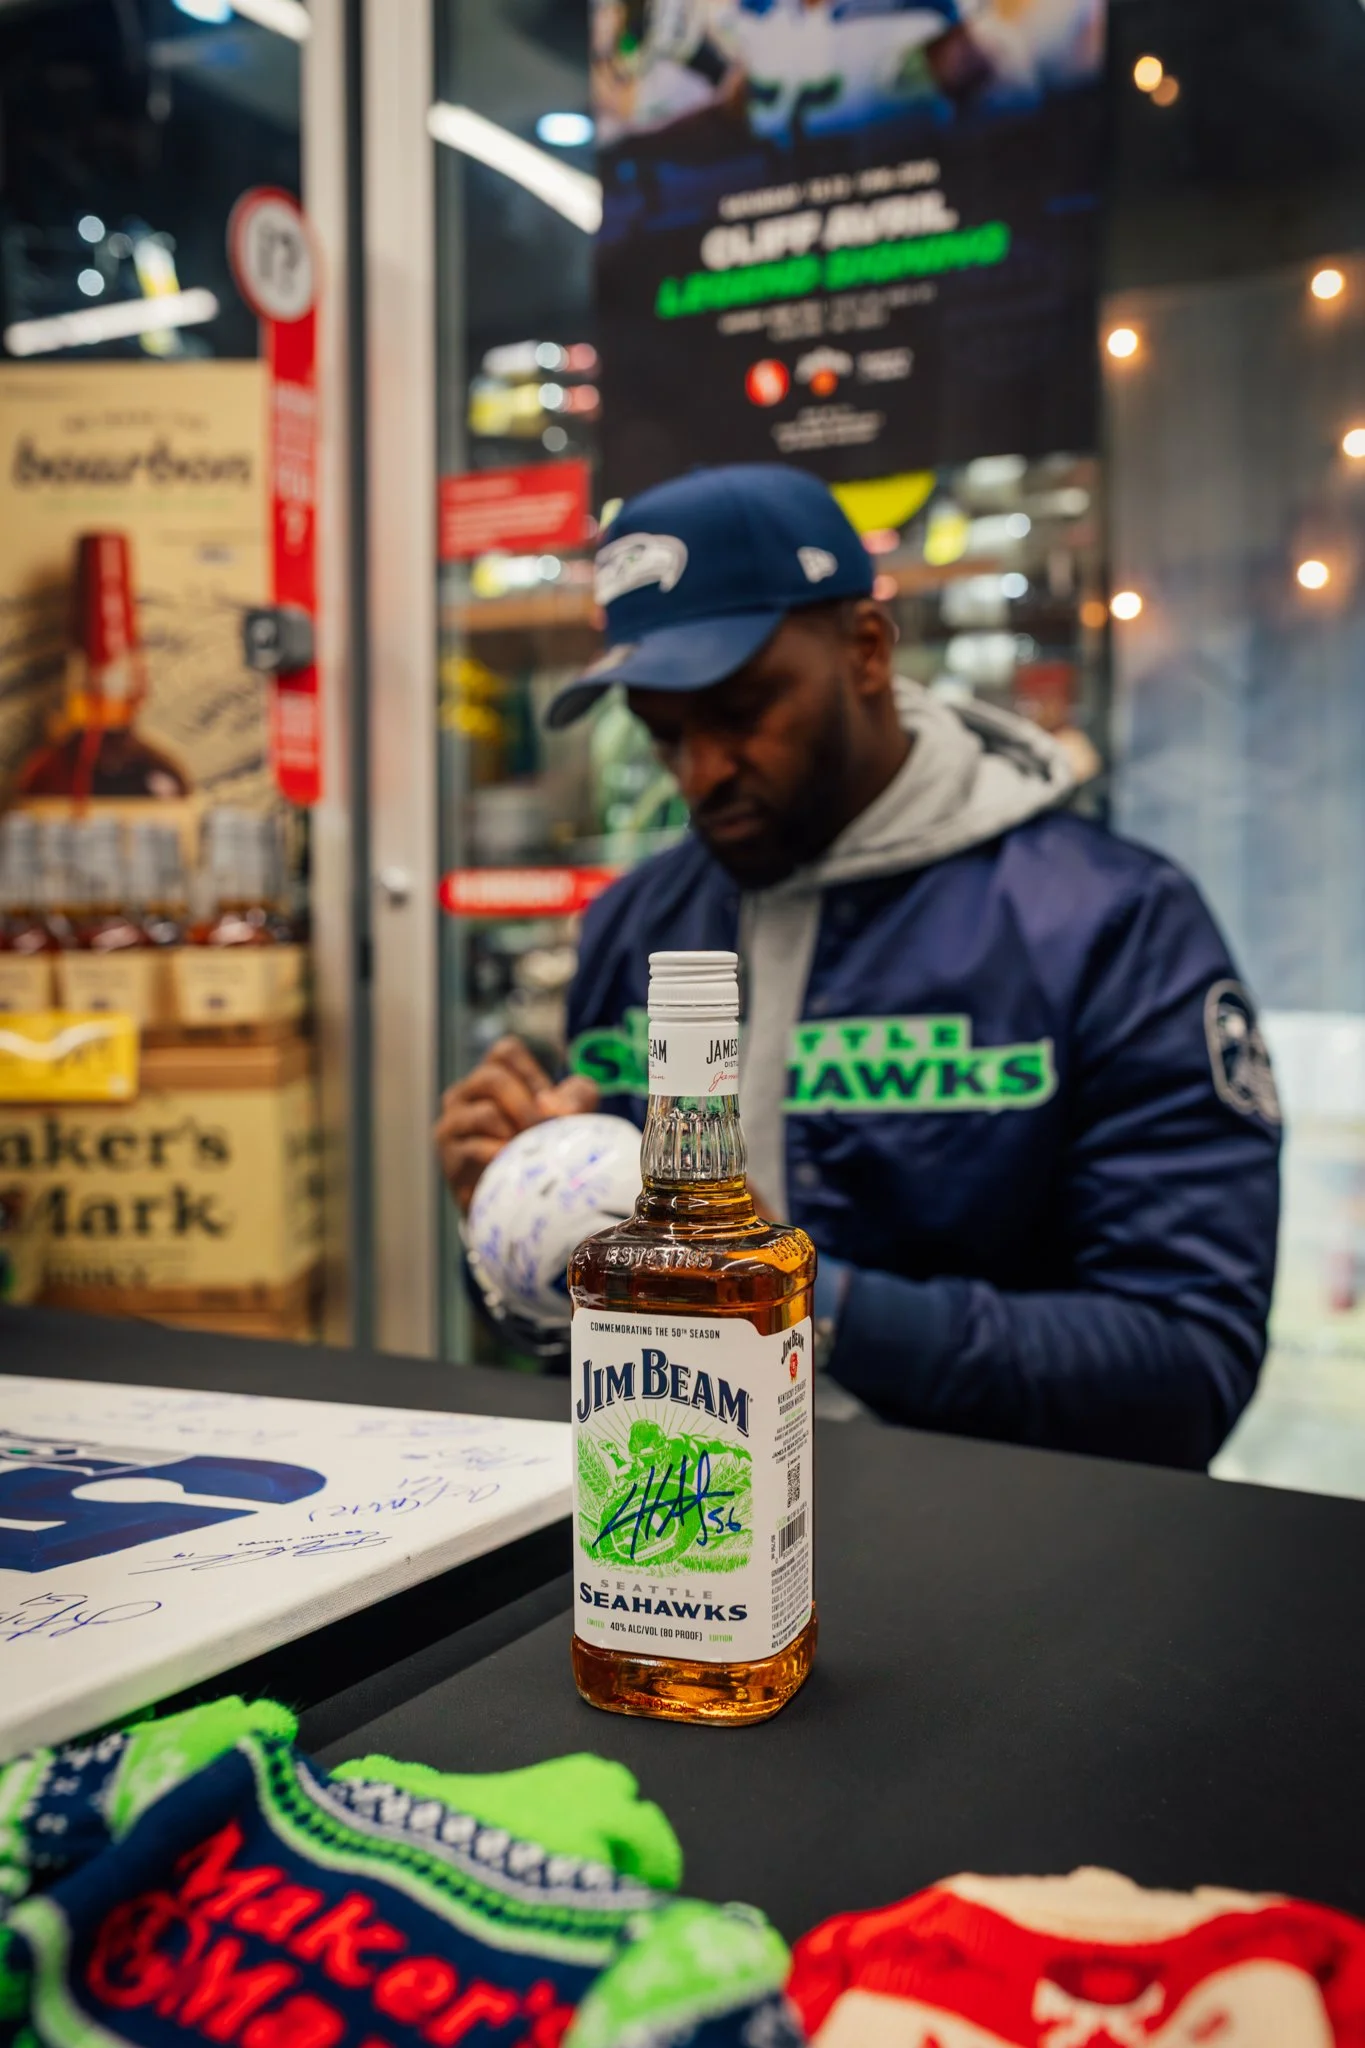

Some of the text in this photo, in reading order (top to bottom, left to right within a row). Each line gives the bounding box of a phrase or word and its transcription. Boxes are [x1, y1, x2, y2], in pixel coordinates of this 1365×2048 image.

[13, 432, 252, 490] bourbon
[706, 1038, 738, 1065] JAMES
[590, 1321, 652, 1336] COMMEMORATING
[655, 1327, 668, 1337] THE
[690, 1328, 720, 1339] SEASON
[576, 1359, 636, 1423] JIM
[641, 1348, 750, 1438] BEAM
[707, 1506, 742, 1534] 56
[579, 1582, 748, 1622] SEAHAWKS
[600, 1579, 713, 1600] SEATTLE
[610, 1621, 627, 1632] 40%
[628, 1624, 658, 1637] ALC/VOL
[675, 1629, 703, 1642] PROOF)
[709, 1634, 733, 1643] EDITION
